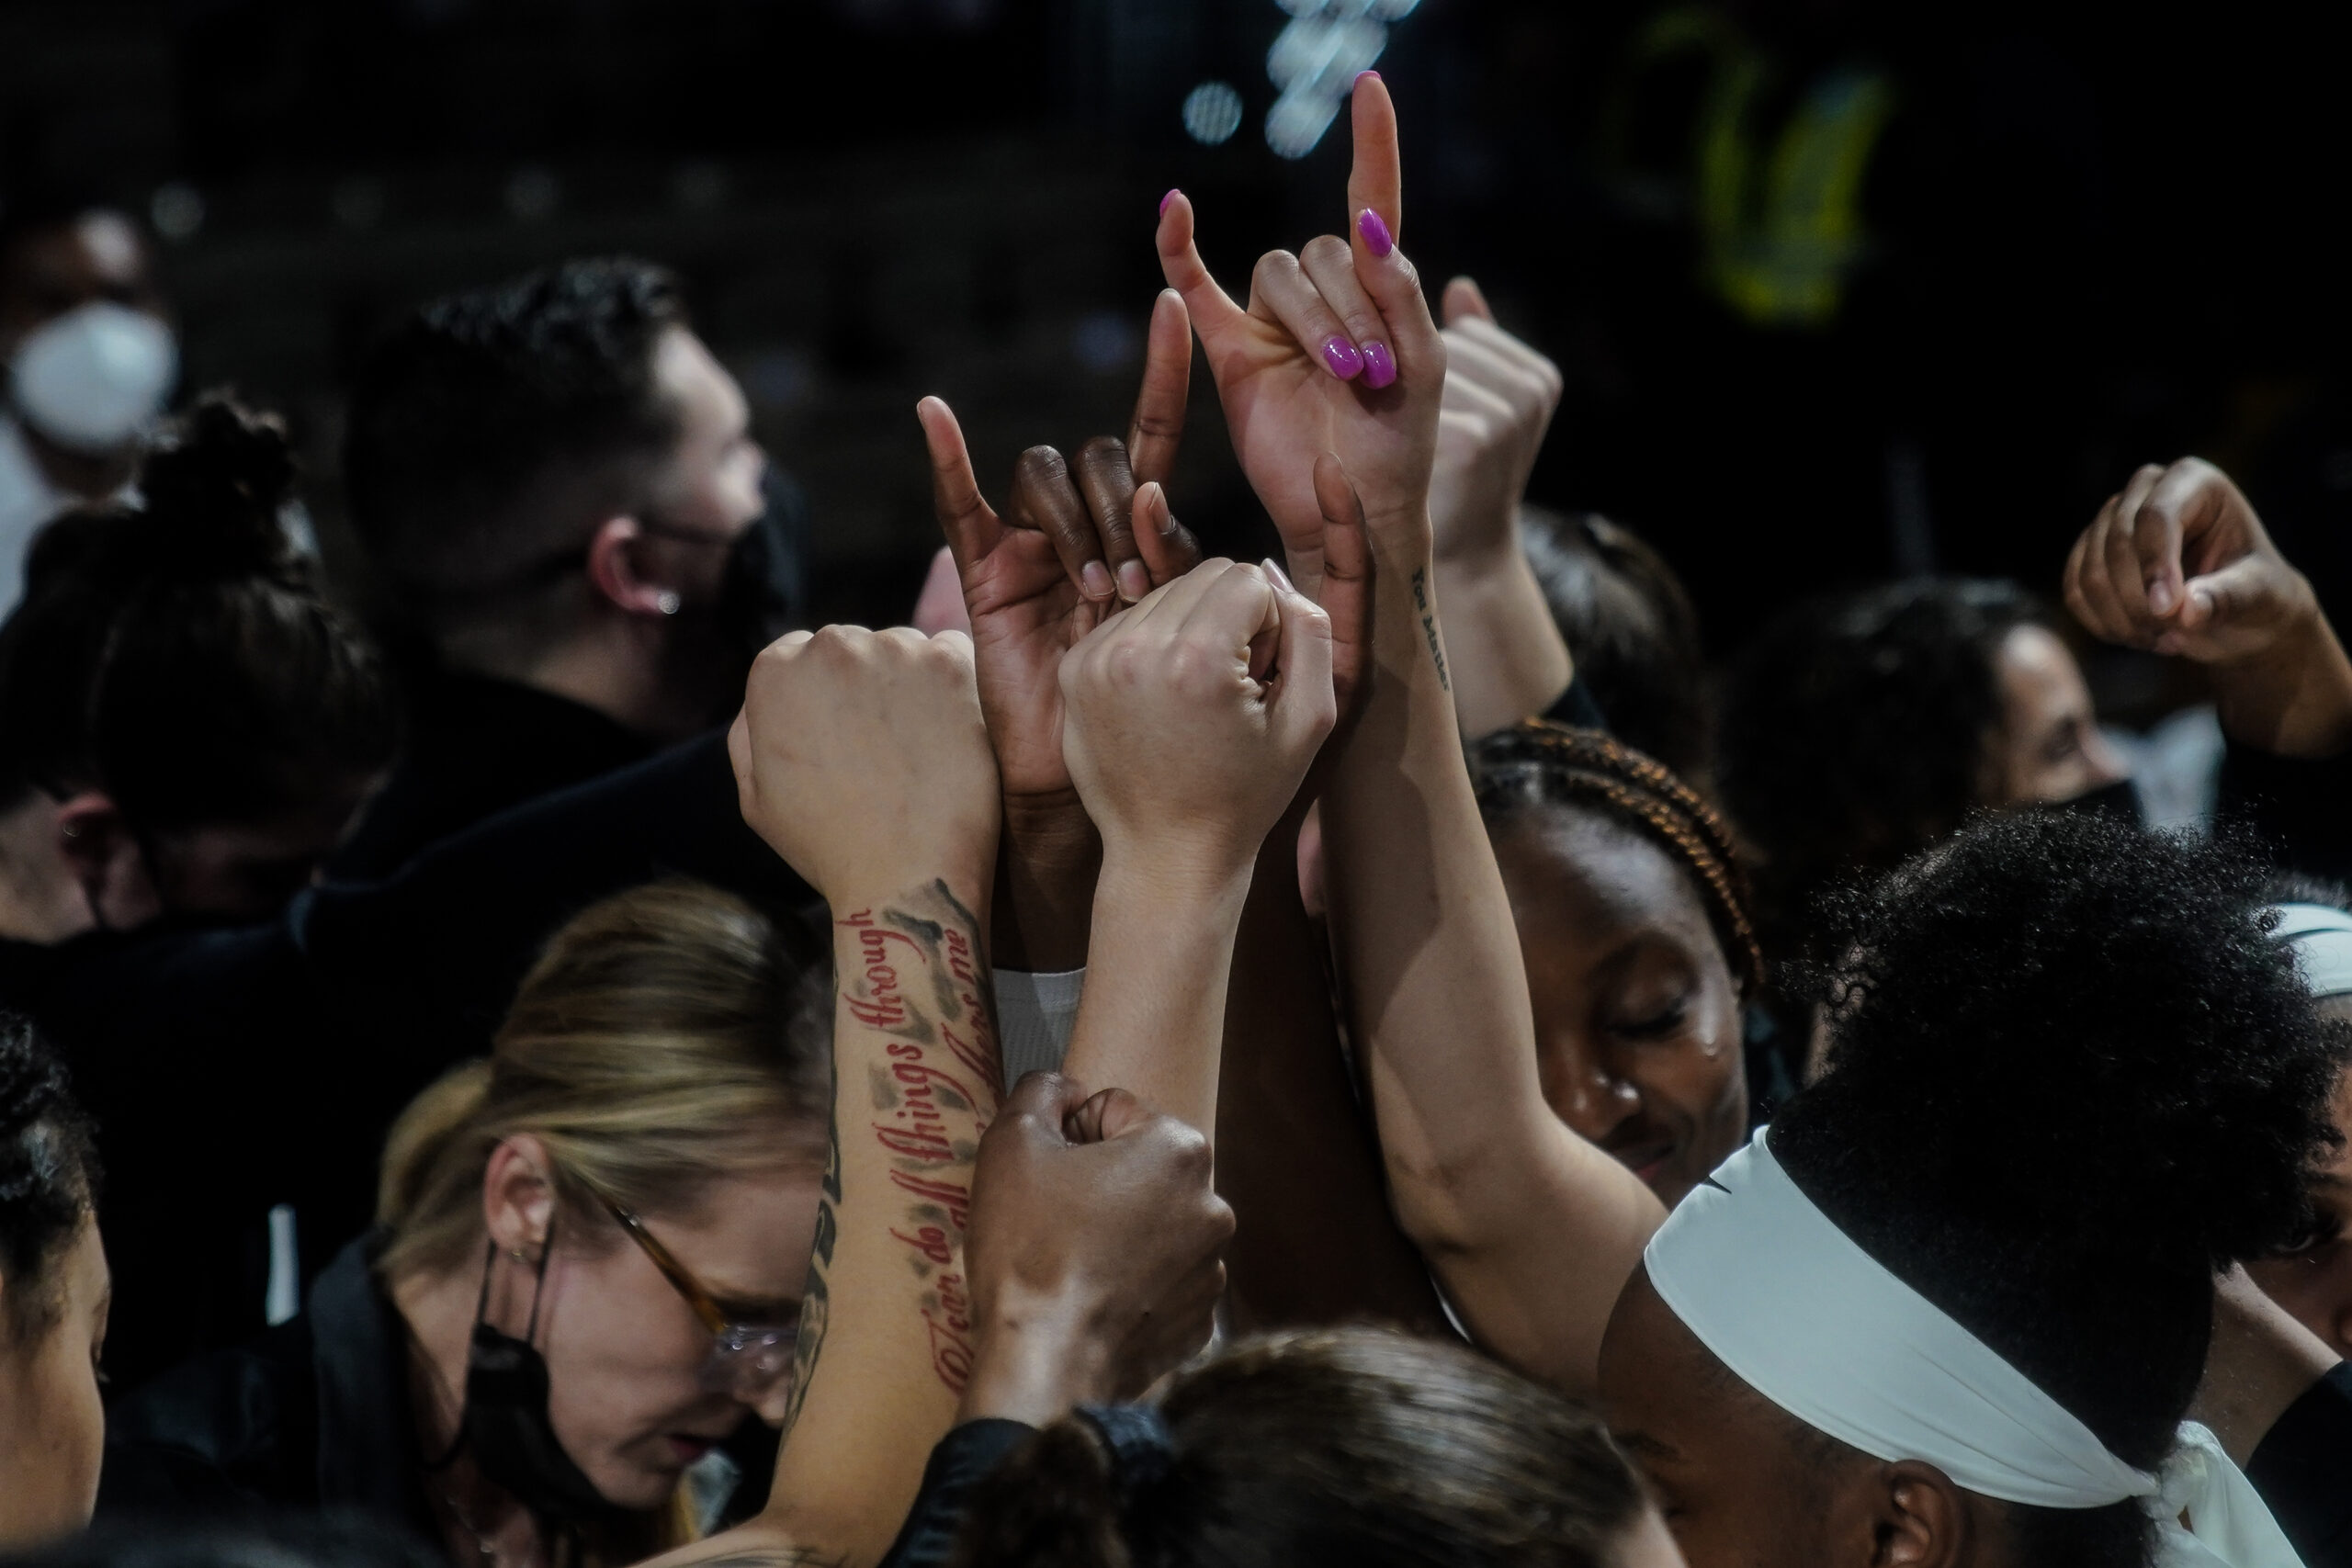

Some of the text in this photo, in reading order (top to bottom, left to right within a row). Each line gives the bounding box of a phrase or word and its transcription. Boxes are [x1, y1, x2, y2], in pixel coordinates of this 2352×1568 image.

[1412, 566, 1427, 612] You
[834, 908, 927, 1027] through
[944, 929, 975, 986] me
[872, 1043, 981, 1161] things
[889, 1168, 969, 1231] all
[889, 1226, 952, 1265] do
